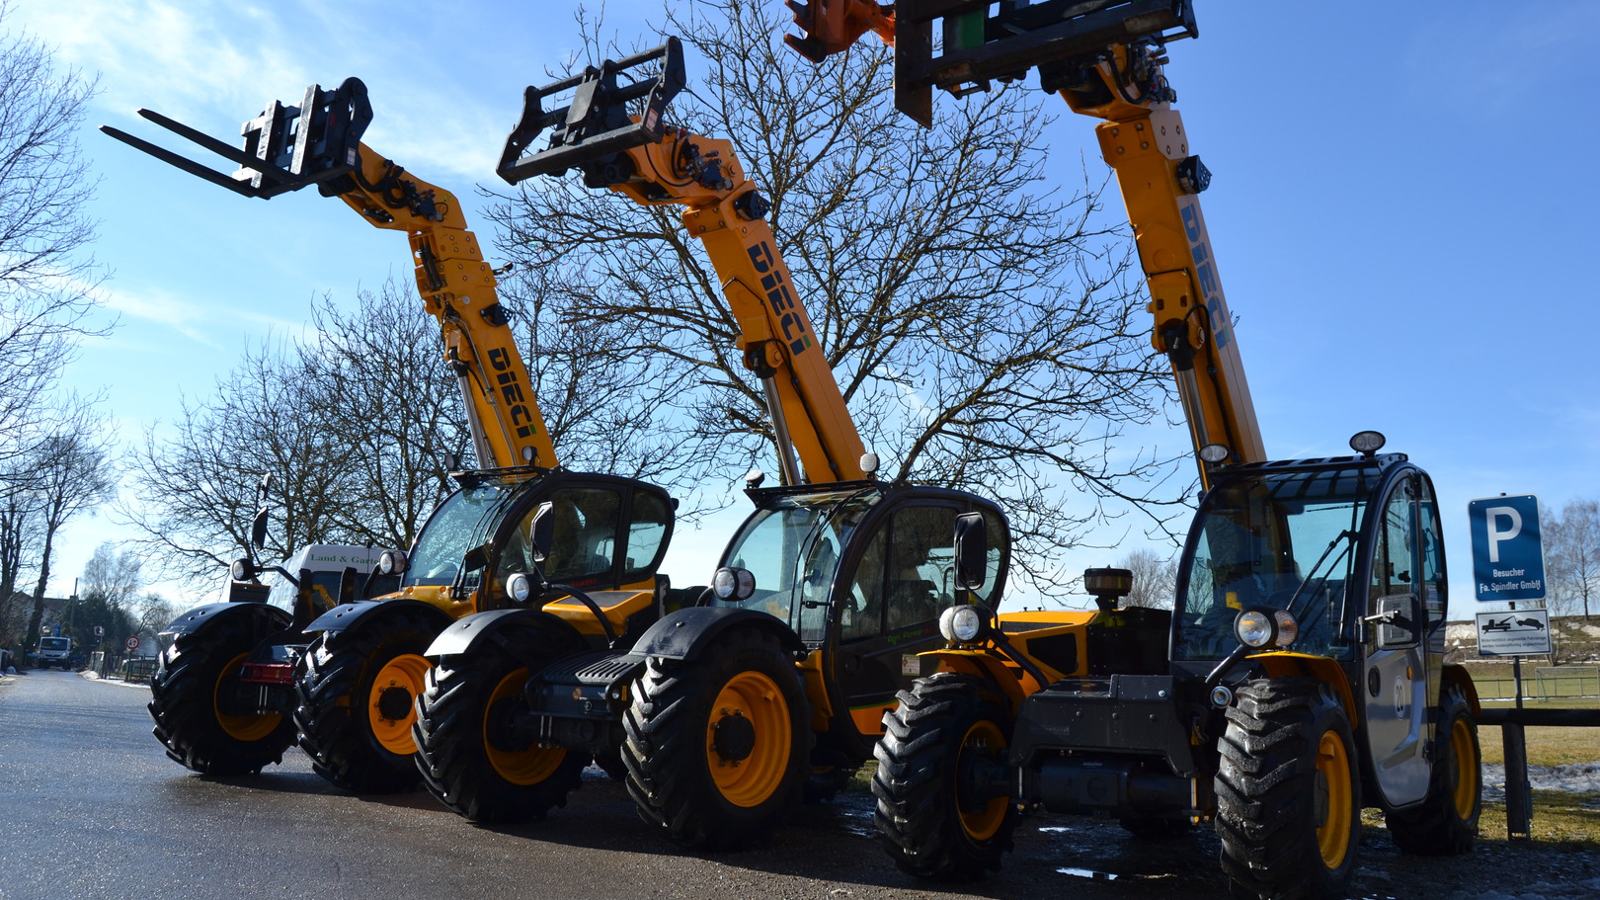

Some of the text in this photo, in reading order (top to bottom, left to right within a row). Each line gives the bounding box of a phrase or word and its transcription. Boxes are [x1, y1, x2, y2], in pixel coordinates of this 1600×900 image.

[1486, 506, 1522, 562] P
[311, 554, 336, 562] Land
[1492, 568, 1525, 578] Besucher
[1479, 583, 1490, 594] Fa.
[1491, 582, 1520, 592] Spindler
